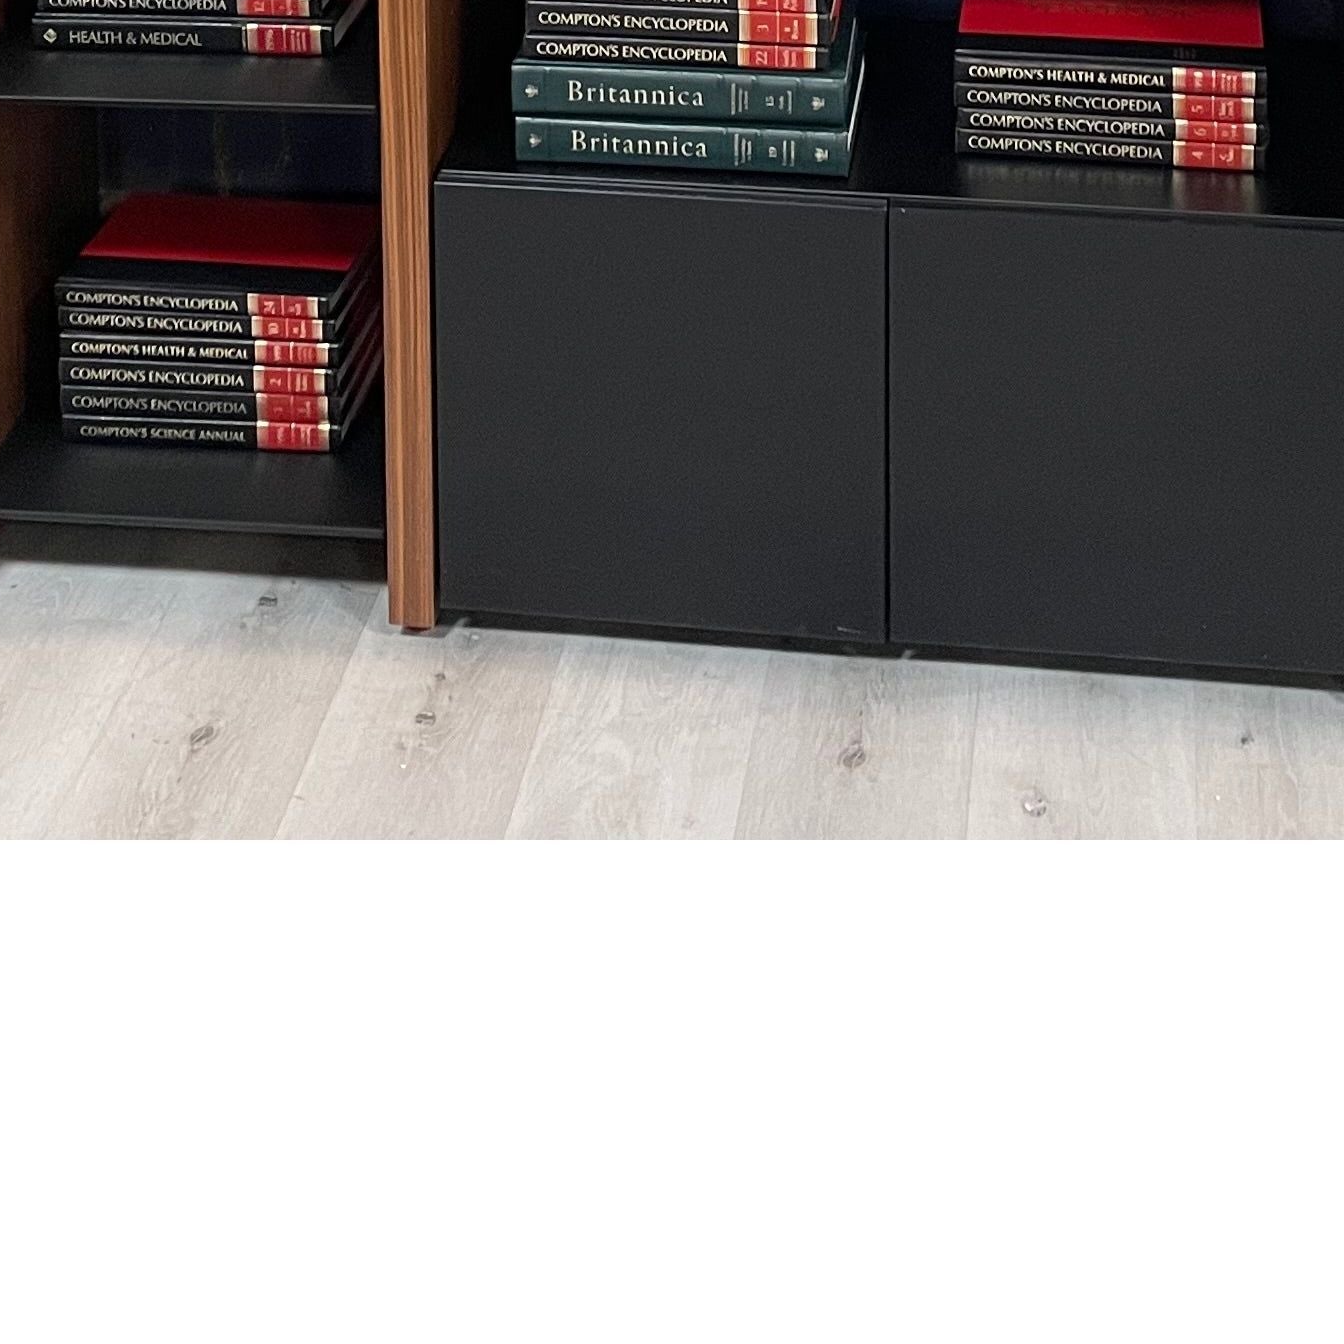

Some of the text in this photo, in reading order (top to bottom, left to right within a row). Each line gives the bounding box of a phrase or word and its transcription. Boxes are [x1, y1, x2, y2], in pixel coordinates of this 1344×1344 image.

[538, 11, 729, 34] COMPTON'S ENCYCLOPEDIA
[69, 30, 202, 47] HEALTH & MEDICAL
[536, 41, 727, 63] COMPTON'S ENCYCLOPEDIA
[755, 50, 768, 65] 22
[968, 65, 1166, 87] COMPTON'S HEALTH & MEDICAL
[567, 79, 704, 108] Britannica
[967, 89, 1162, 113] COMPTON'S ENCYCLOPEDIA
[969, 113, 1165, 137] COMPTON'S ENCYCLOPEDIA
[570, 129, 708, 158] Britannica
[968, 135, 1163, 160] COMPTON'S ENCYCLOPEDIA
[66, 290, 239, 312] COMPTON'S ENCYCLOPEDIA
[69, 313, 243, 333] COMPTON'S ENCYCLOPEDIA
[71, 341, 248, 360] COMPTON'S HEALTH & MEDICAL
[70, 367, 244, 387] COMPTON'S ENCYCLOPEDIA
[71, 395, 247, 414] COMPTON'S ENCYCLOPEDIA
[80, 425, 246, 442] COMPTON'S SCIENCE ANNUAL
